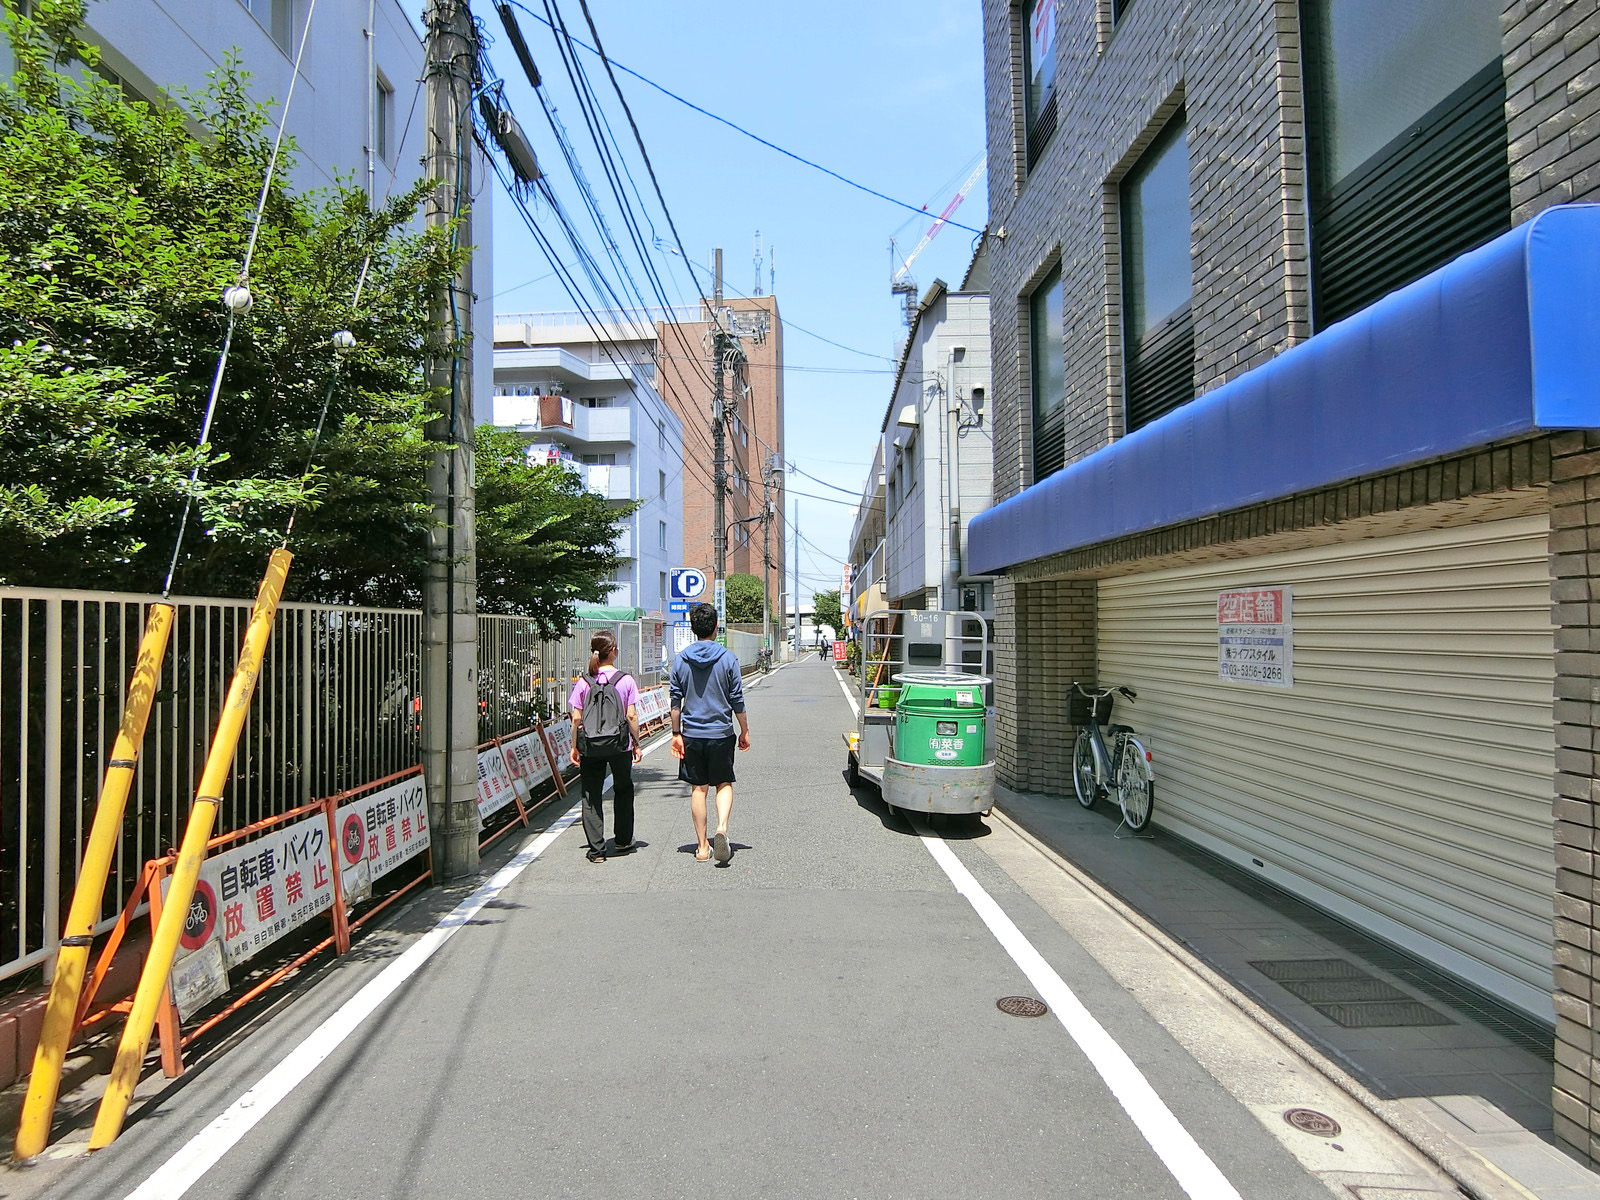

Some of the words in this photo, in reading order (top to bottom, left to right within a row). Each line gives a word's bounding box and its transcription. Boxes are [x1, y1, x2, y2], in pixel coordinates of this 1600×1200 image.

[686, 575, 699, 593] P
[913, 614, 939, 622] 60-16
[1222, 592, 1275, 622] 空店舗
[1229, 664, 1282, 680] 03-5356-3266
[365, 785, 424, 832] 自転車・バイク
[368, 812, 427, 862] 放置禁止
[220, 827, 324, 901] 自転車・バイク
[223, 858, 329, 942] 放置禁止
